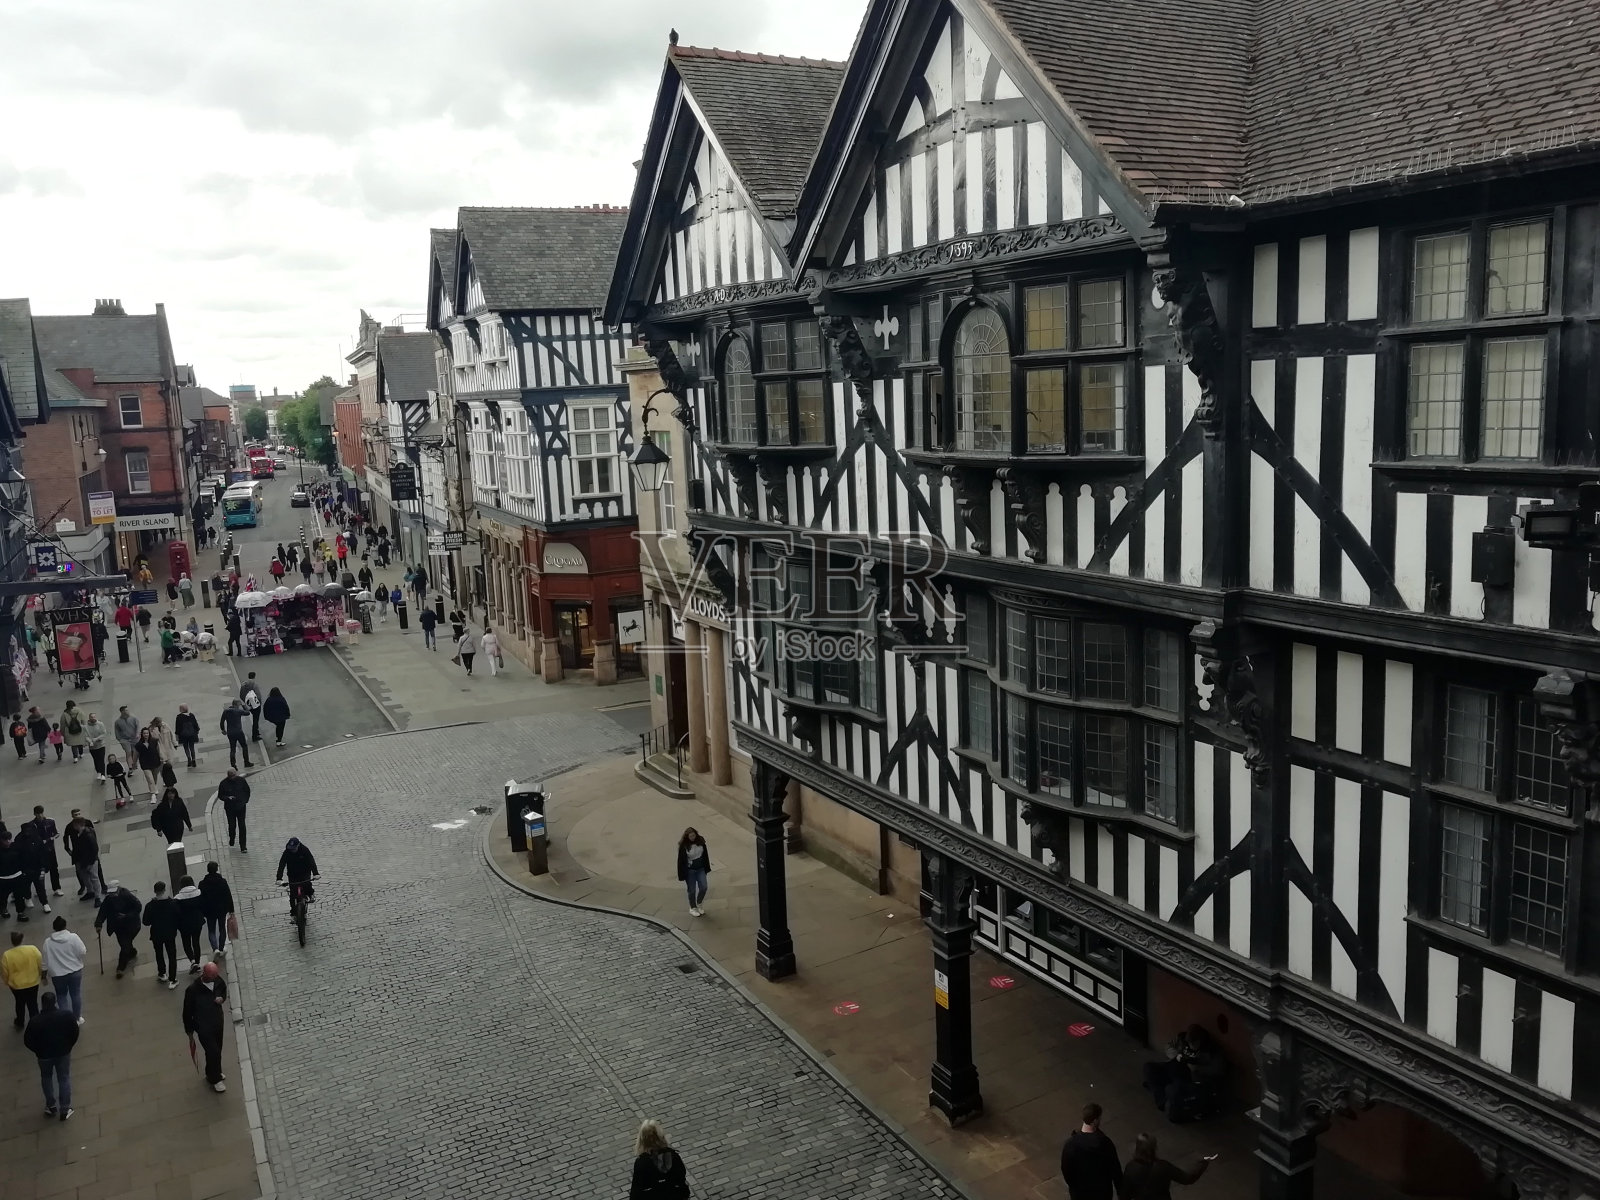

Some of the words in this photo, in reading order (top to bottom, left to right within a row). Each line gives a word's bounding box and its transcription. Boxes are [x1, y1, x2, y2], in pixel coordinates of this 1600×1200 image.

[119, 519, 141, 528] RIVER
[143, 517, 170, 527] ISLAND
[544, 554, 584, 568] CLOGAU
[690, 594, 726, 622] LLOYDS
[53, 609, 90, 622] WHS
